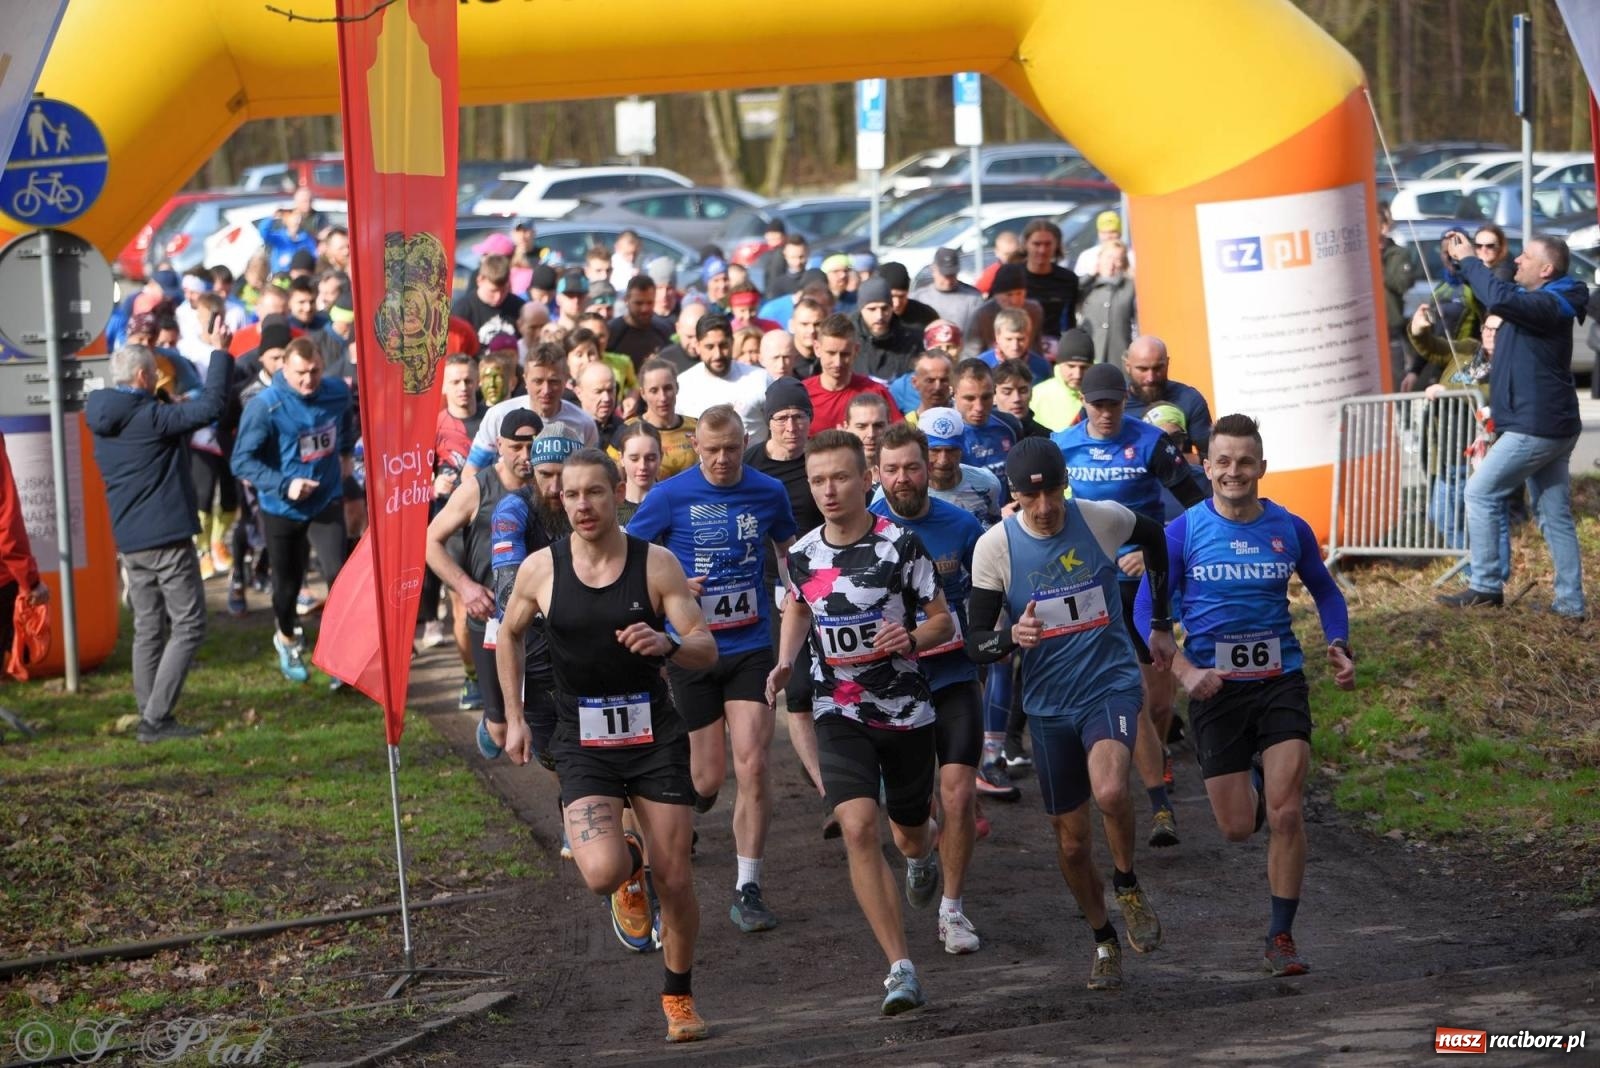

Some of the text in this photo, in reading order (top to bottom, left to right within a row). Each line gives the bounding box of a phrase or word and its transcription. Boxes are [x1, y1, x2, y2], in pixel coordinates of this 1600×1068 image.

[312, 433, 330, 450] 16
[1192, 562, 1296, 581] RUNNERS
[715, 592, 750, 617] 44
[1063, 596, 1079, 621] 1
[826, 623, 877, 653] 105
[1231, 642, 1269, 668] 66
[603, 707, 630, 734] 11
